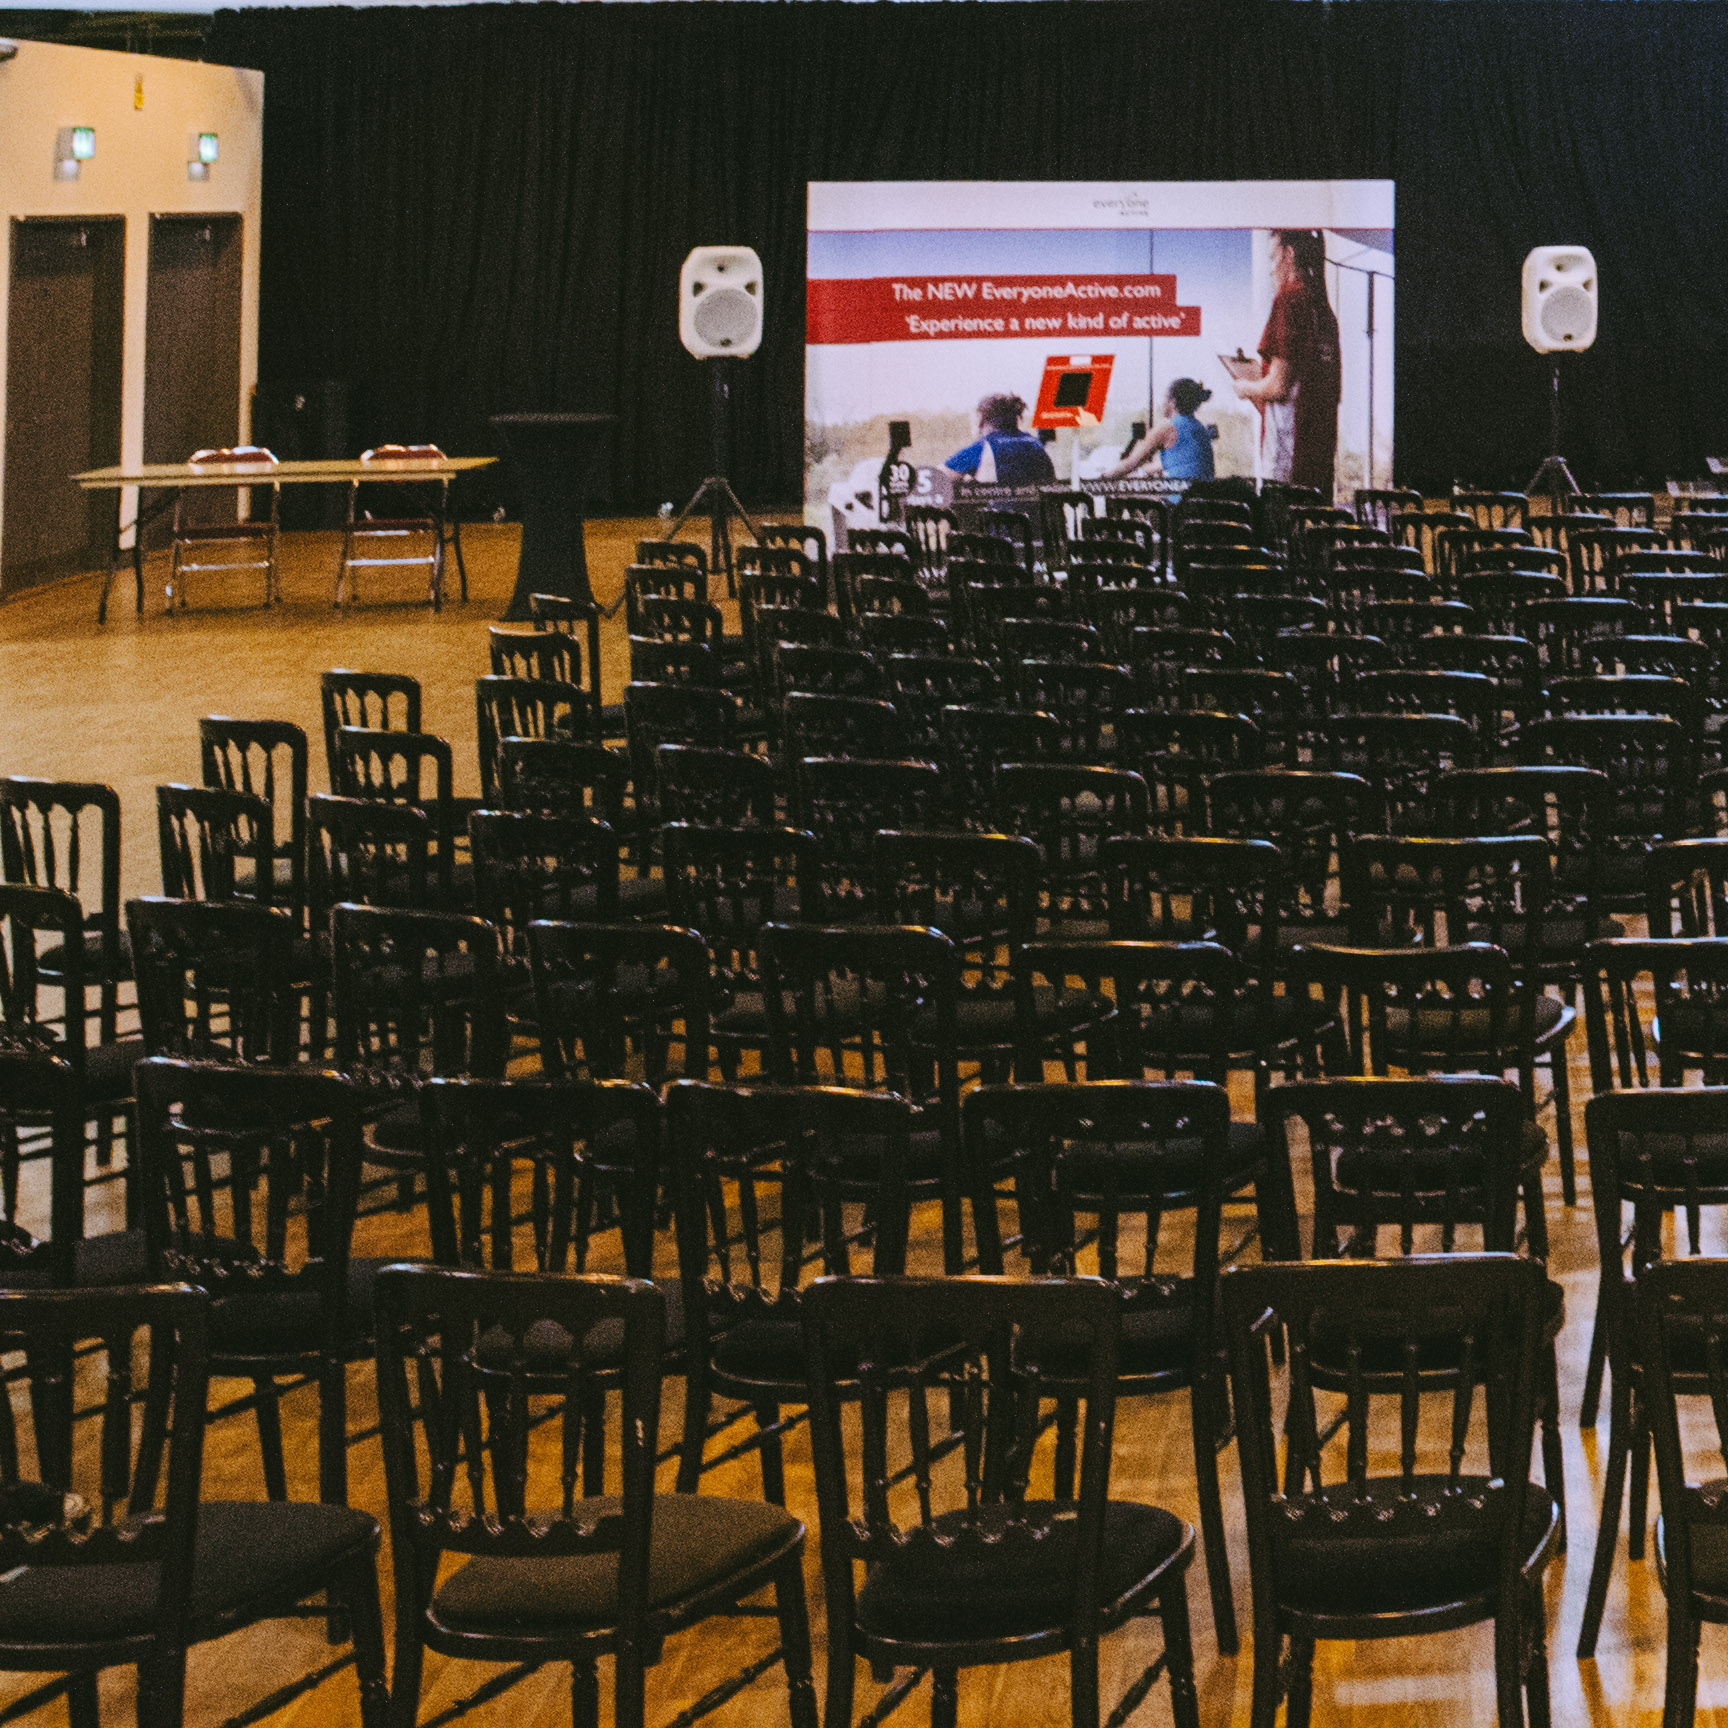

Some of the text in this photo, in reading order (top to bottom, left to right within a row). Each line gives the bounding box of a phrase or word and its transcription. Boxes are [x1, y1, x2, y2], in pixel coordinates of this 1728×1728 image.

[892, 282, 1161, 303] The NEW EveryoneActive.com
[905, 311, 1185, 336] ‘Experience a new kind of active’
[917, 469, 932, 493] 5
